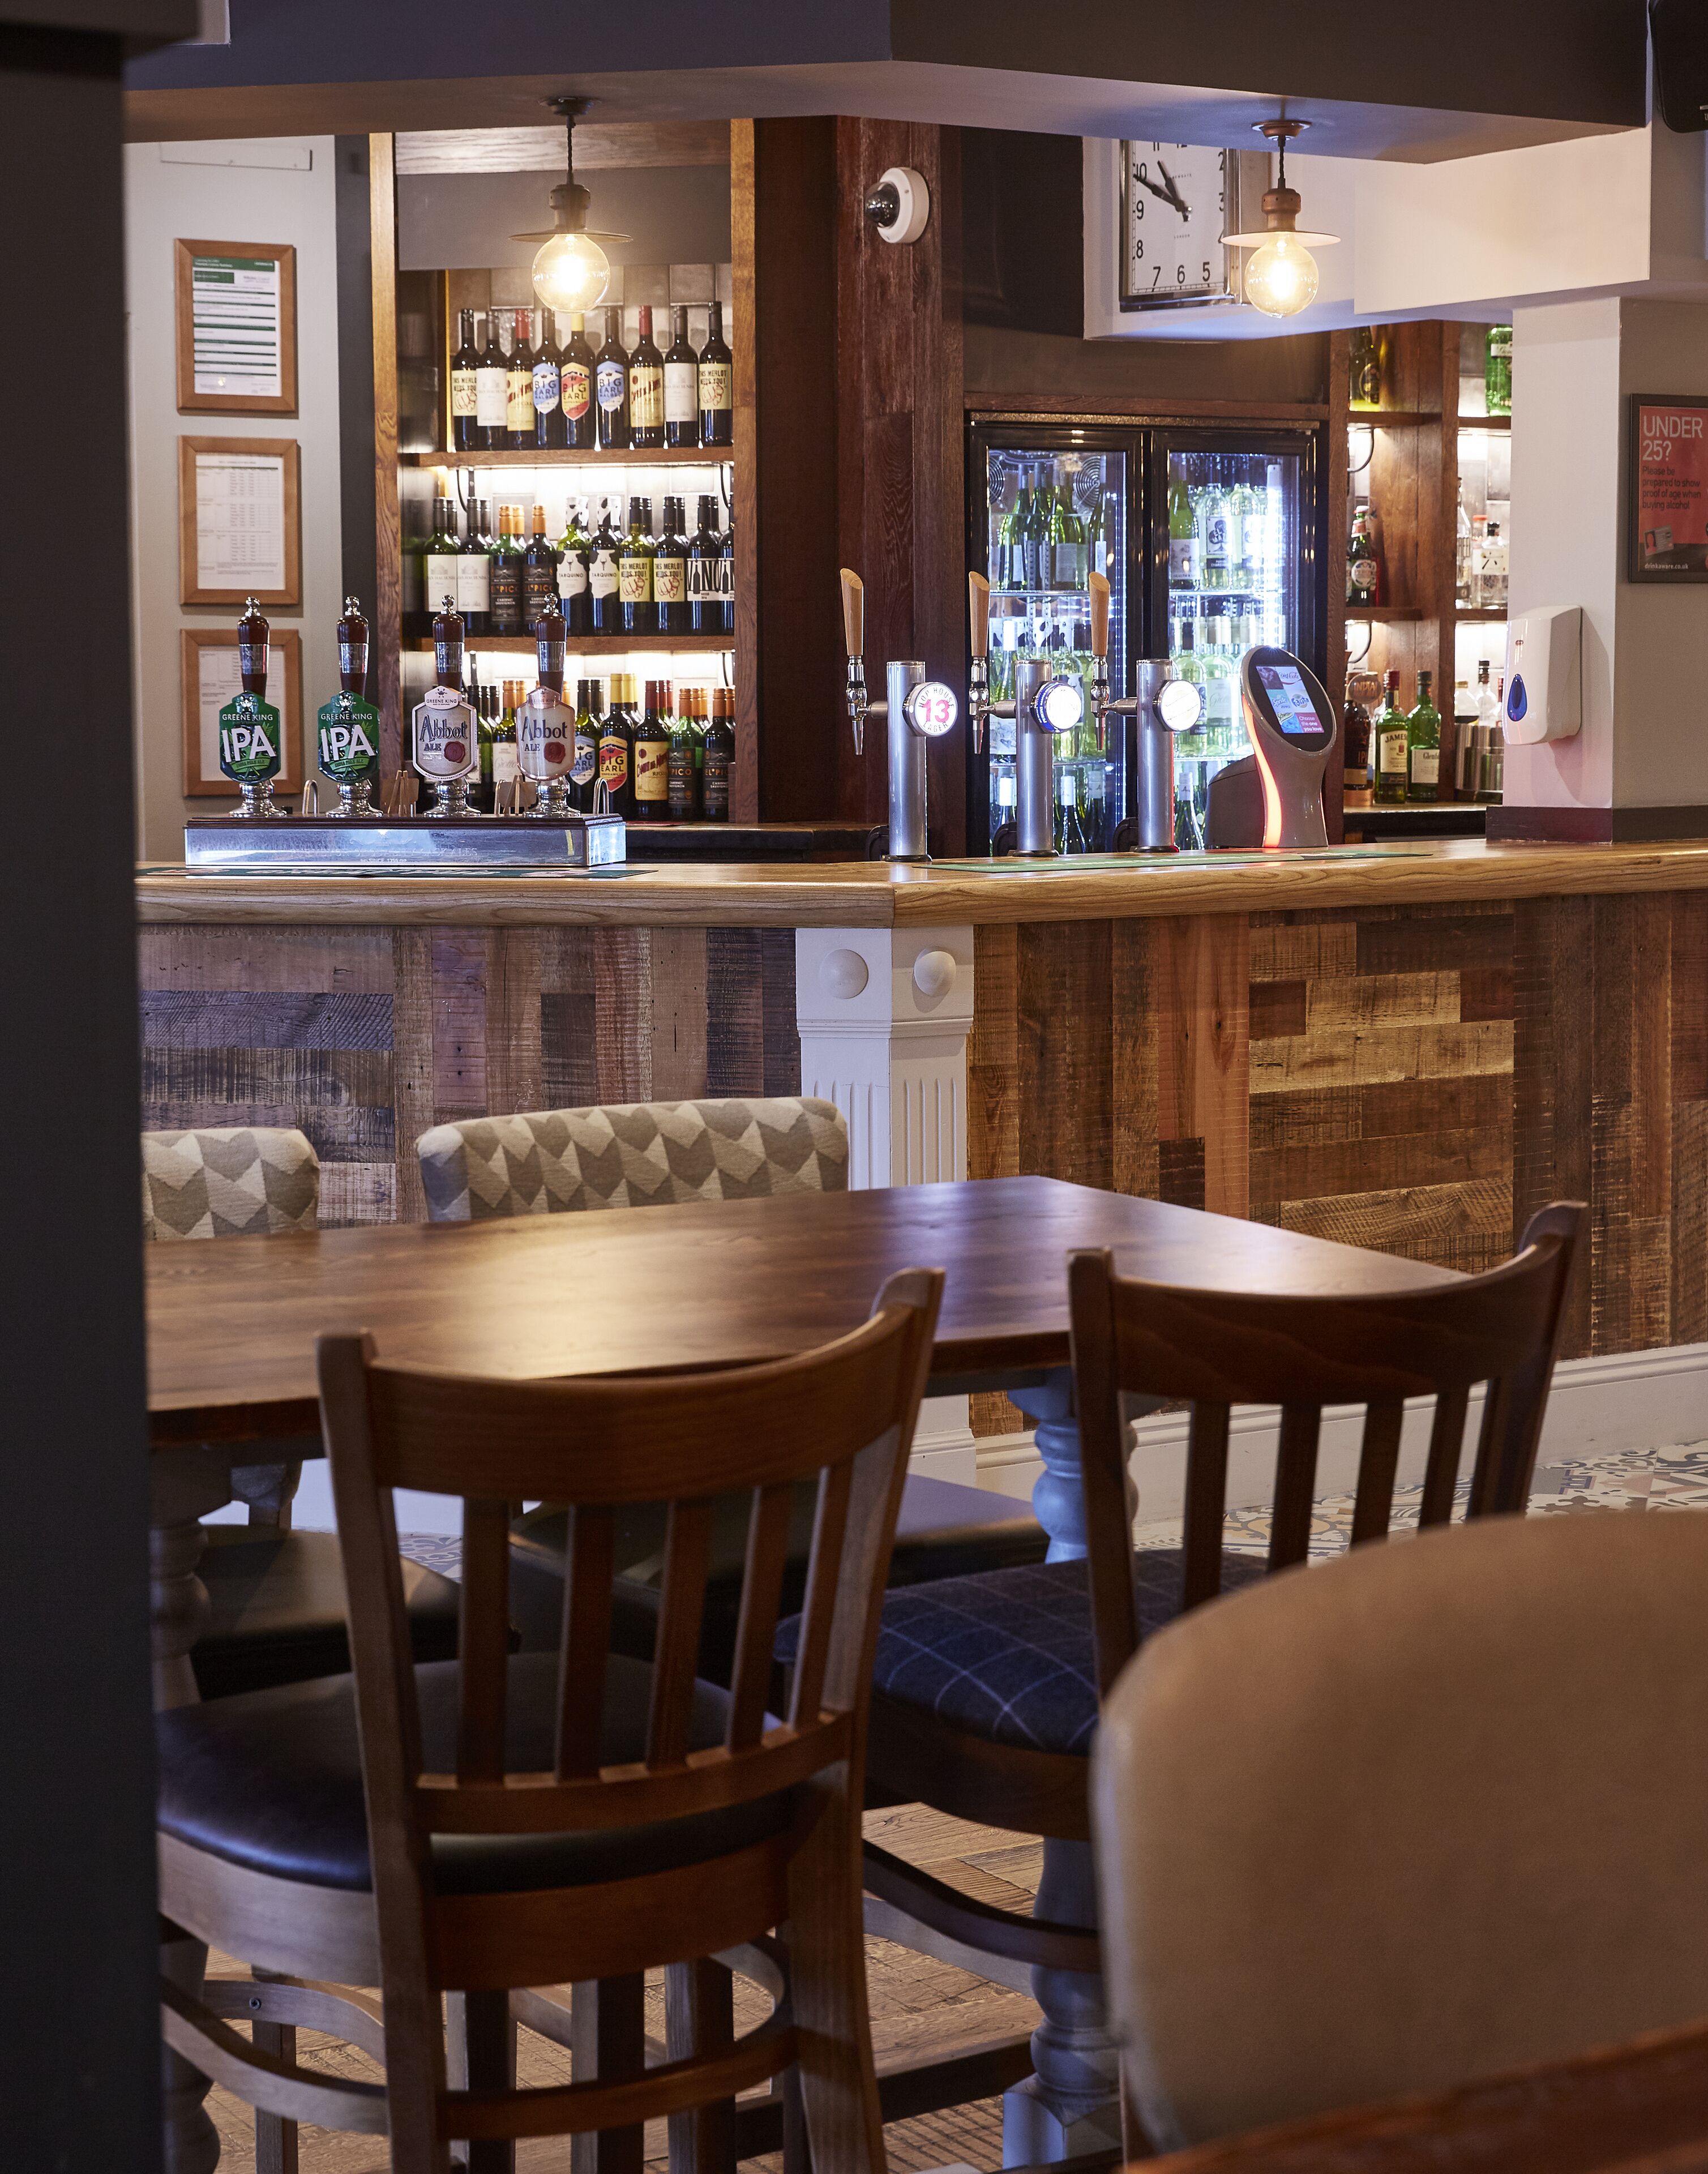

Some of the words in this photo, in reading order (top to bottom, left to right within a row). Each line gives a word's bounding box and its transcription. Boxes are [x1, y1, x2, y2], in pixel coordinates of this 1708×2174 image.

[1136, 162, 1147, 181] 10
[1136, 200, 1144, 220] 9
[1136, 239, 1144, 259] 8
[1153, 266, 1161, 286] 7
[1177, 265, 1185, 284] 6
[1202, 262, 1211, 282] 5
[534, 380, 557, 389] BIG
[563, 383, 586, 392] BIG
[600, 378, 622, 387] BIG
[1643, 415, 1703, 438] UNDER
[1642, 440, 1672, 461] 25?
[1643, 467, 1665, 475] Please
[1667, 467, 1675, 475] be
[1642, 479, 1673, 489] prepared
[1642, 489, 1660, 499] proof
[1661, 489, 1668, 498] of
[1668, 491, 1681, 500] age
[1682, 490, 1701, 499] when
[1642, 499, 1665, 510] buying
[1666, 500, 1690, 509] alcohol
[923, 699, 950, 723] 13
[1291, 697, 1309, 707] Fanta
[419, 714, 468, 742] Abbot
[521, 716, 568, 742] Abbot
[923, 720, 948, 733] LAGER
[221, 725, 276, 763] IPA
[320, 724, 376, 762] IPA
[423, 743, 441, 751] ALE
[575, 752, 593, 760] IG
[601, 755, 624, 765] BIG
